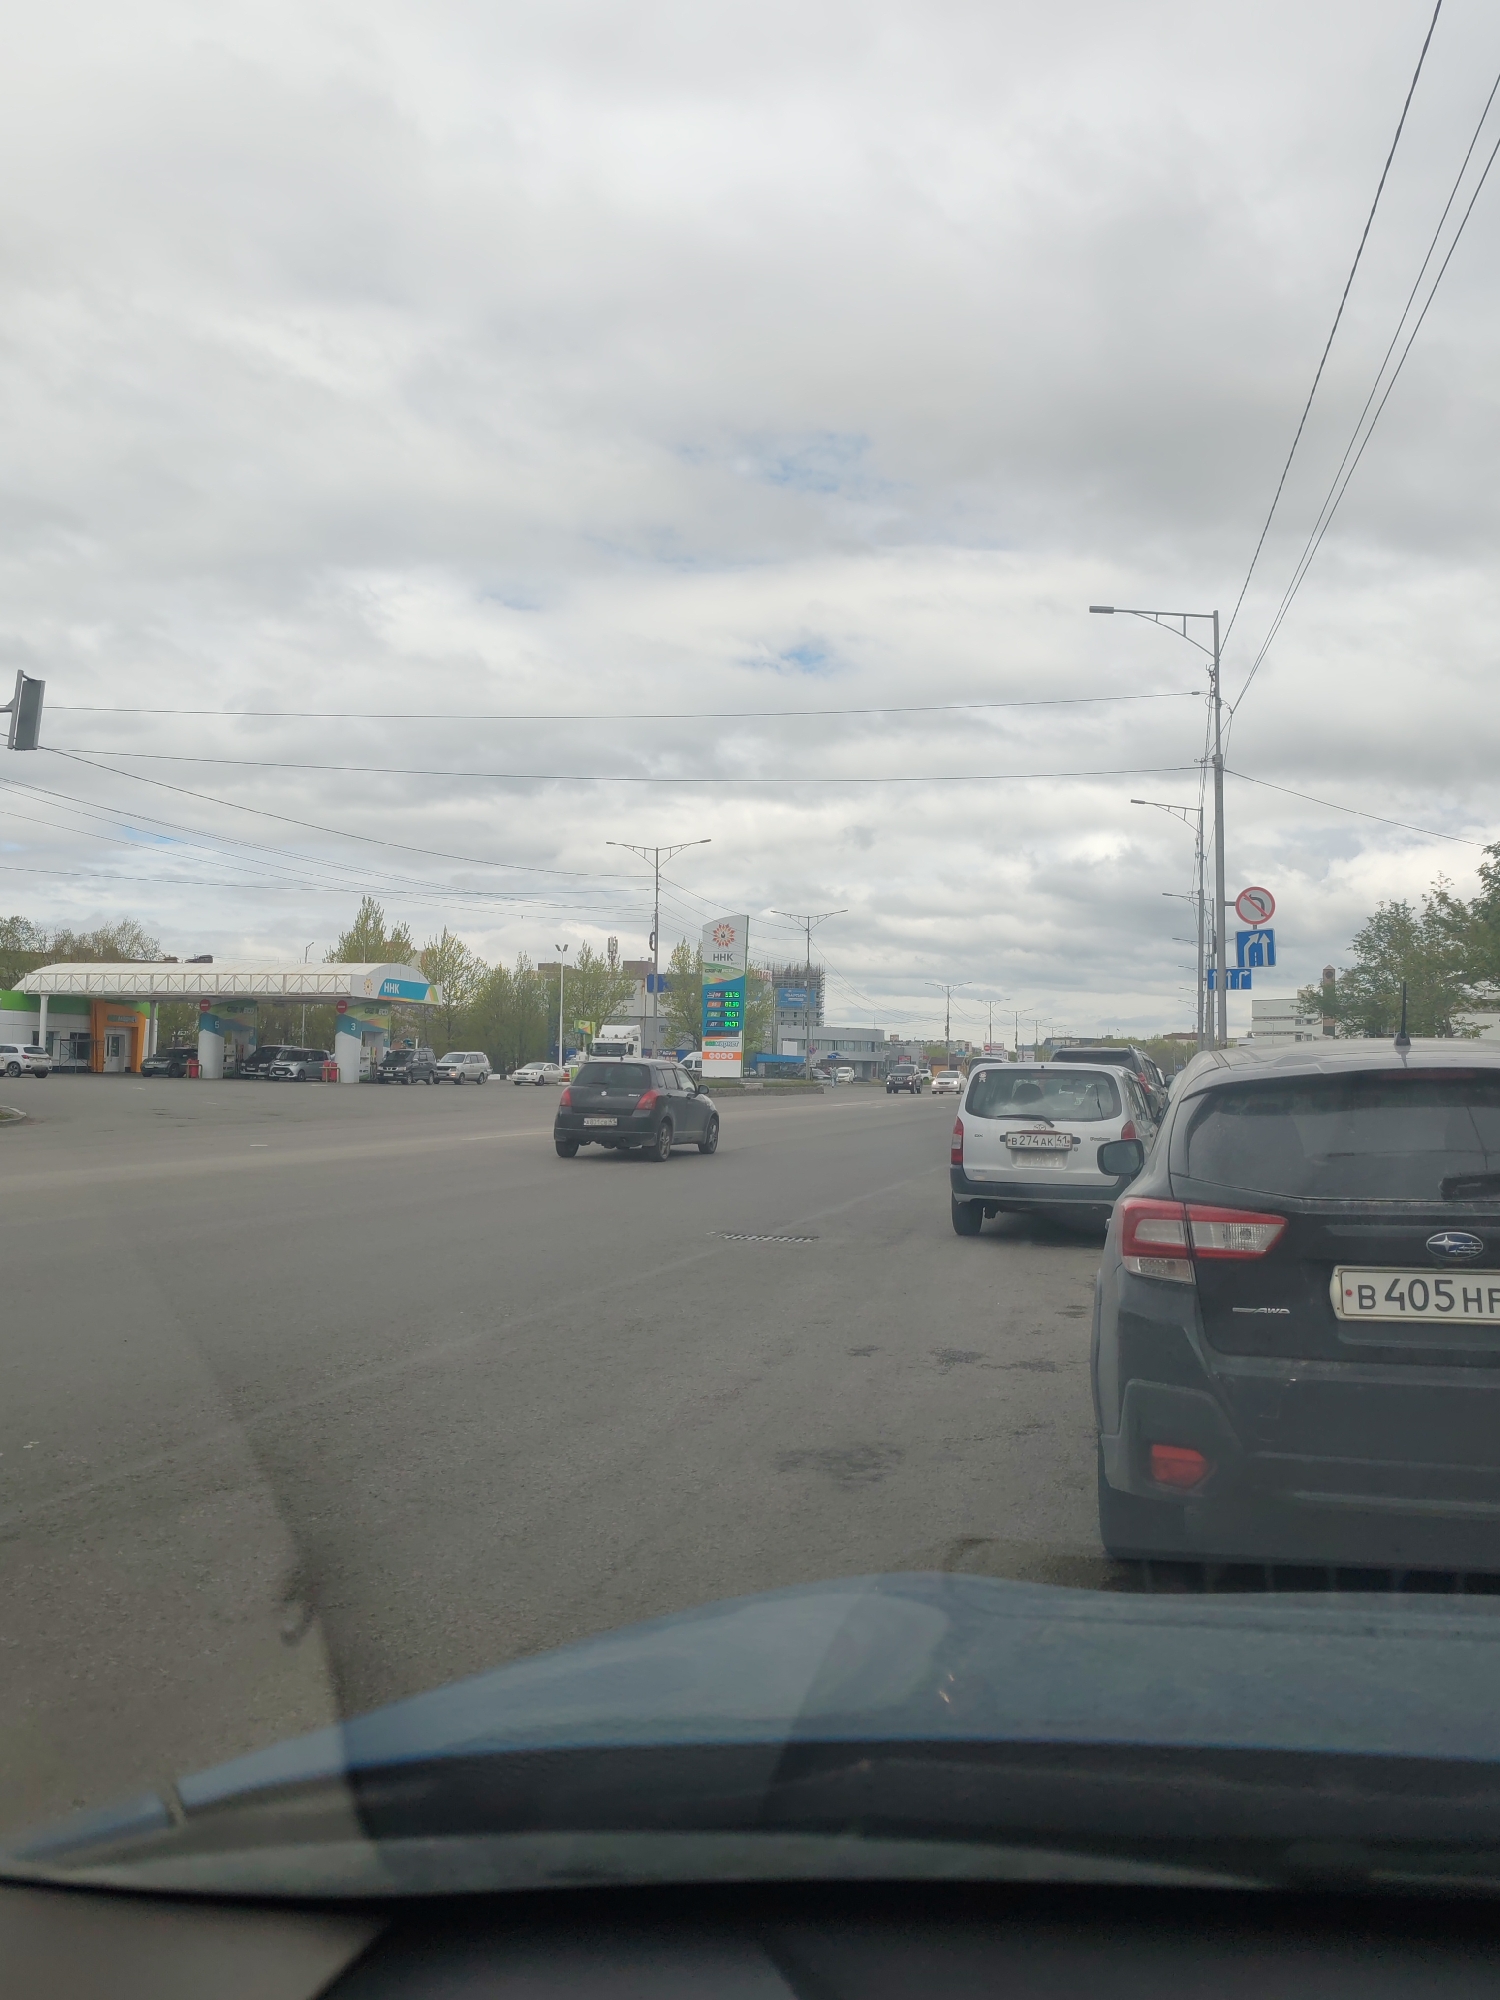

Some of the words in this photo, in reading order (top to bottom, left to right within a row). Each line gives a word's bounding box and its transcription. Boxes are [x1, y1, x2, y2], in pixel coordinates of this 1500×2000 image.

[713, 953, 733, 961] ННК
[384, 982, 400, 994] ННК
[214, 1020, 220, 1029] 5
[350, 1022, 356, 1031] 3
[1011, 1135, 1054, 1147] В274АК
[1056, 1135, 1068, 1144] 41
